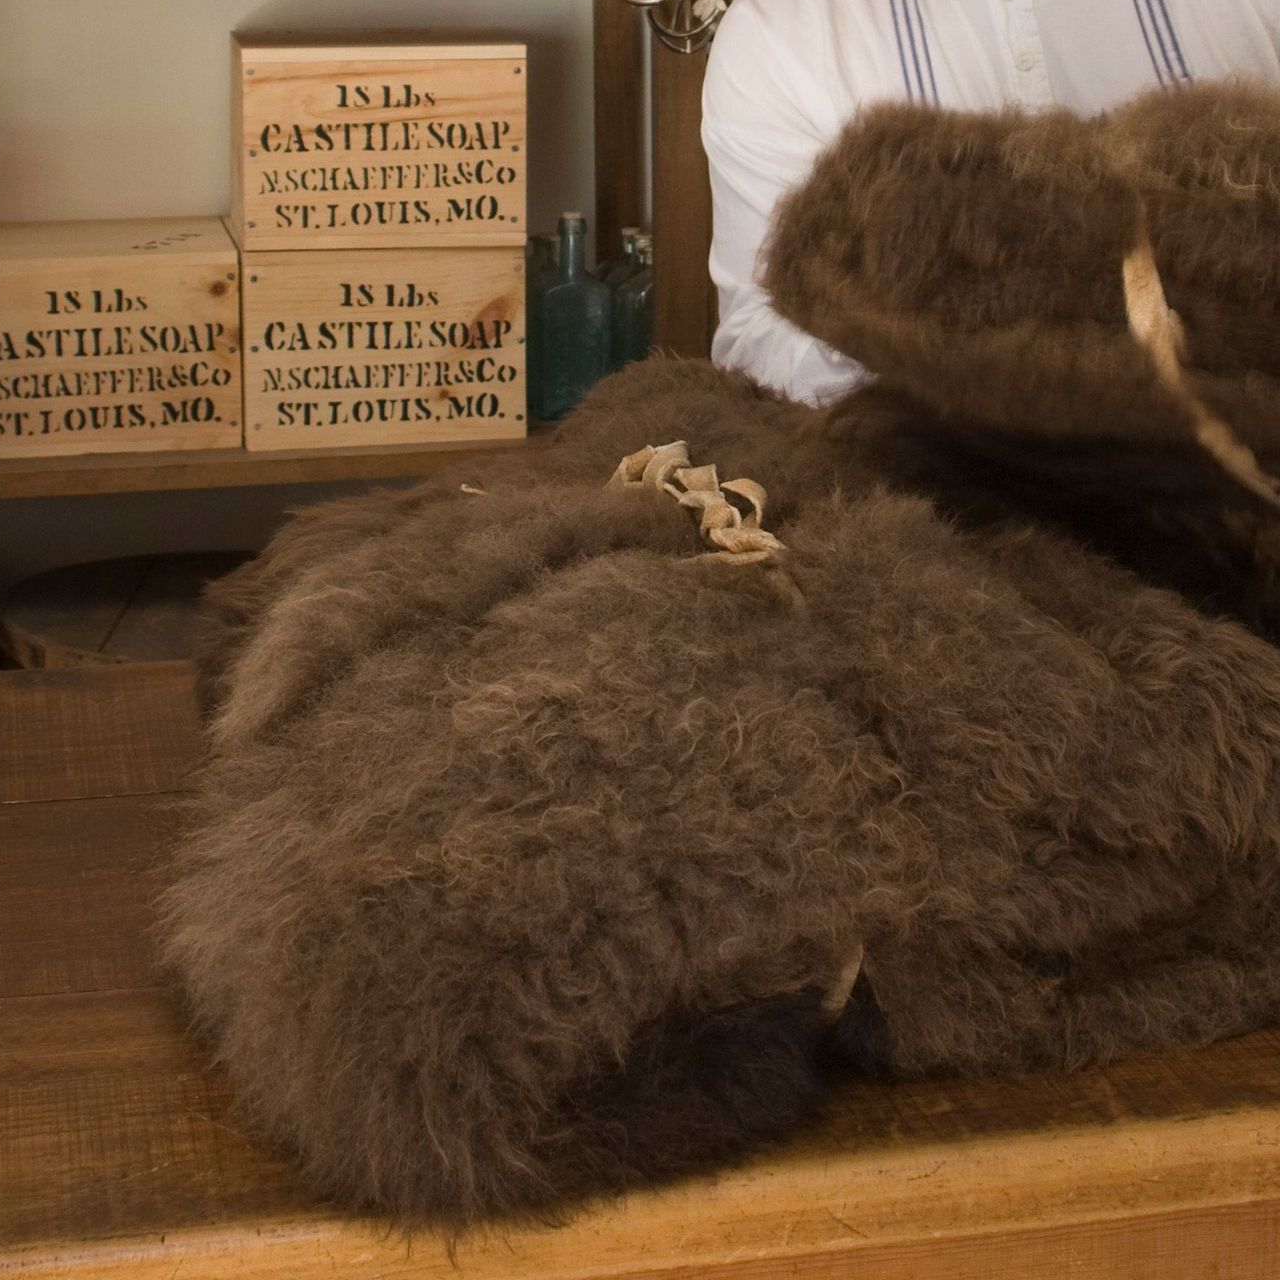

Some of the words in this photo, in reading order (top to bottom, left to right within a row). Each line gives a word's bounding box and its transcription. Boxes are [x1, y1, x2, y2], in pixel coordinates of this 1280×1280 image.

[382, 84, 436, 107] Lbs
[260, 121, 420, 153] CASTILE
[427, 121, 510, 150] SOAP
[447, 194, 505, 222] MO.
[91, 288, 148, 313] Lbs
[386, 283, 439, 307] Lbs
[139, 322, 224, 353] SOAP
[264, 320, 423, 351] CASTILE
[429, 320, 511, 349] SOAP
[161, 397, 222, 426] MO.
[448, 393, 505, 420] MO.
